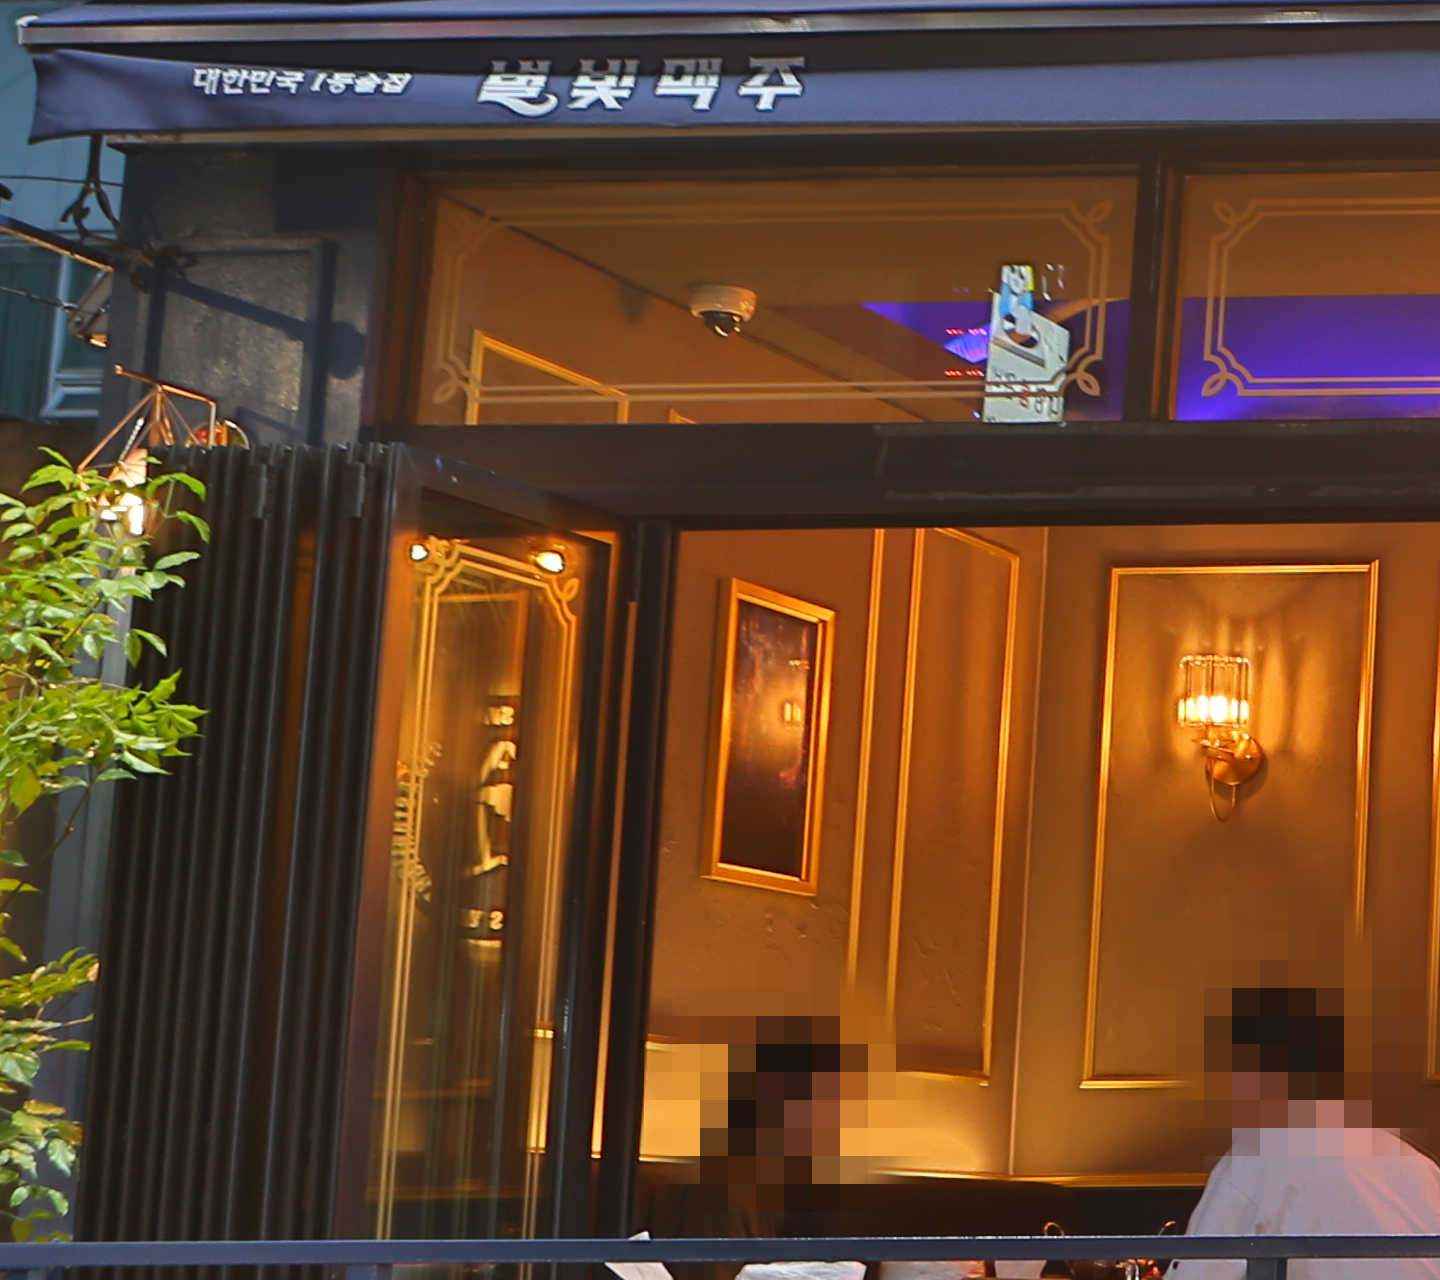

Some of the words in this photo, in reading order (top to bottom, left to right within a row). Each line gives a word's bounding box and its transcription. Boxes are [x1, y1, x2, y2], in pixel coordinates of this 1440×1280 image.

[193, 68, 305, 96] 대한민국
[311, 70, 411, 95] 1등술집
[478, 56, 806, 118] 별빛맥주
